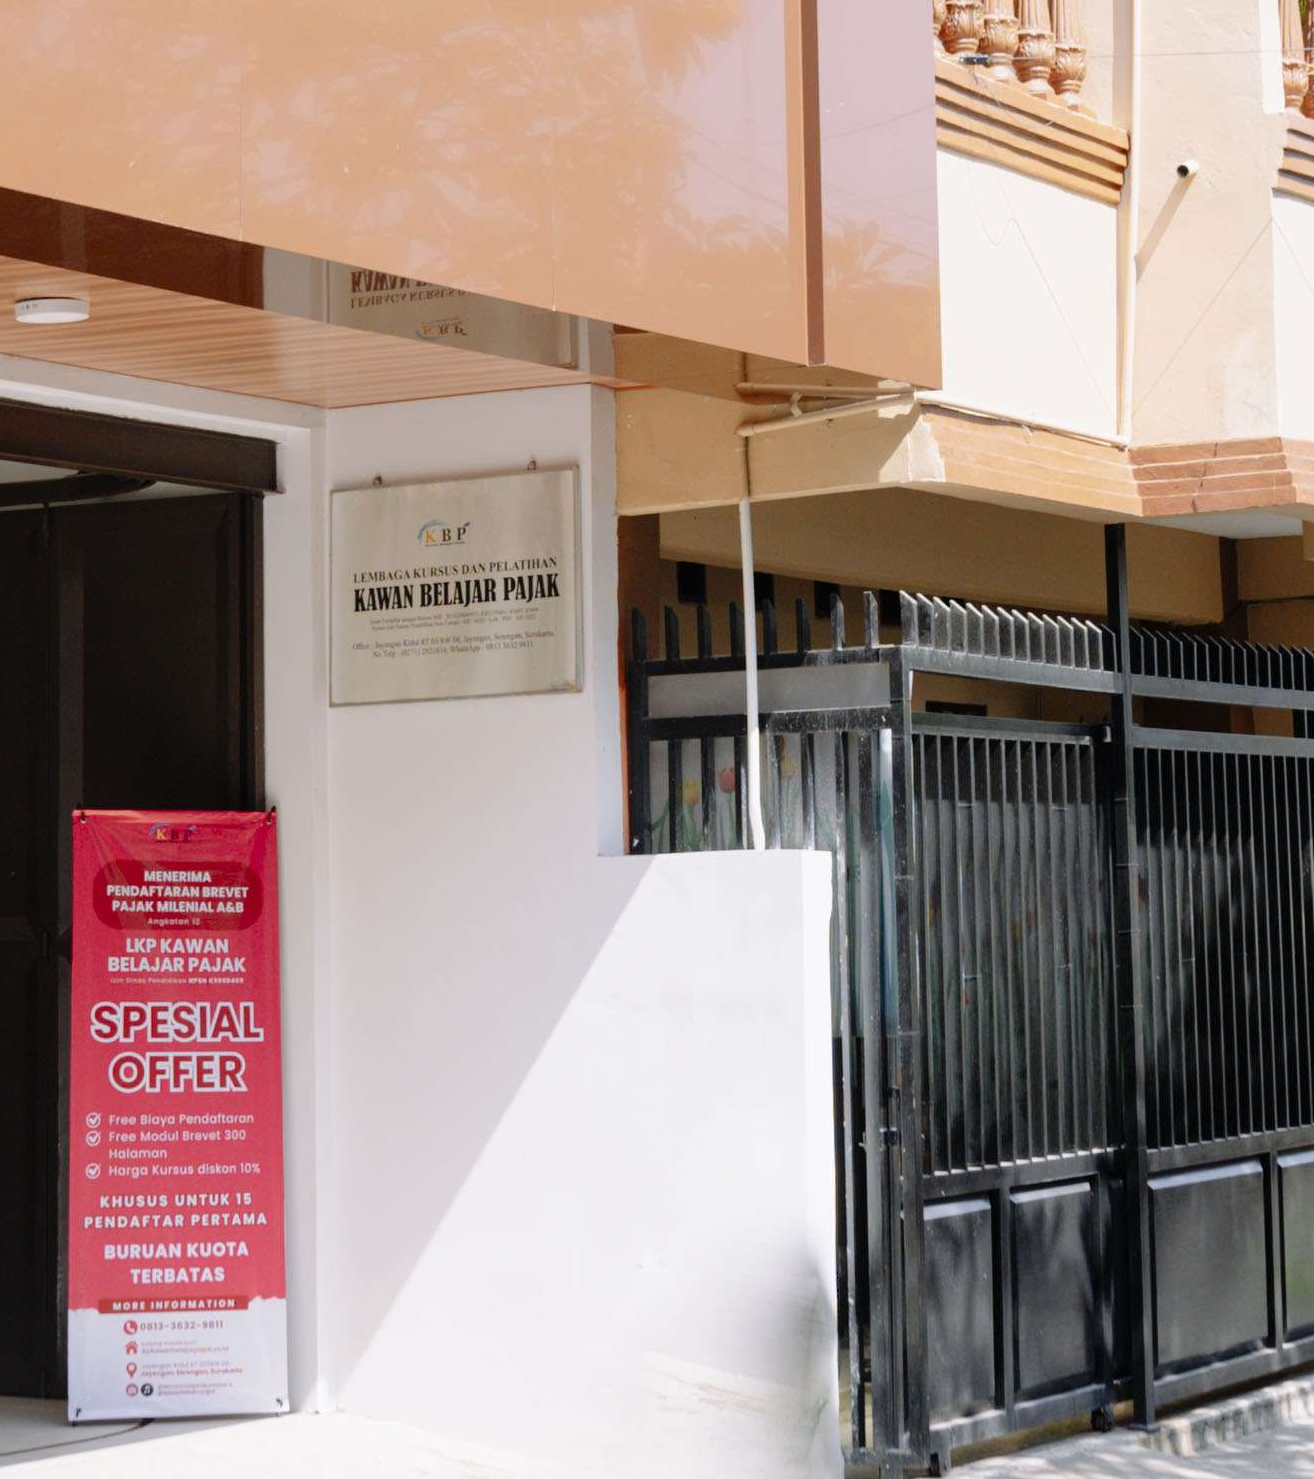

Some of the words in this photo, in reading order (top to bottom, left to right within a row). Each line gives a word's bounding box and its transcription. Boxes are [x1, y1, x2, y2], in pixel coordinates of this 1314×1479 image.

[354, 570, 411, 584] LEMBAGA
[414, 565, 458, 578] KURSUS
[462, 563, 486, 576] DAN
[489, 557, 557, 572] PELATIHAN
[354, 585, 413, 612] KAWAN
[421, 578, 496, 607] BELAJAR
[503, 574, 559, 602] PAJAK
[144, 871, 211, 883] MENERIMA
[107, 885, 200, 898] PENDAFTARAN
[202, 886, 249, 898] BREVET
[112, 901, 154, 912] PAJAK
[157, 901, 214, 913] MILENIAL
[217, 902, 244, 913] A&B
[126, 938, 157, 954] LKP
[160, 938, 229, 954] KAWAN
[108, 956, 184, 972] BELAJAR
[189, 957, 246, 972] PAJAK
[90, 1001, 264, 1043] SPESIAL
[109, 1052, 248, 1093] OFFER
[109, 1114, 137, 1126] Free
[141, 1114, 175, 1127] Biaya
[179, 1113, 254, 1124] Pendaftaran
[109, 1132, 137, 1142] Free
[141, 1131, 179, 1141] Modul
[183, 1130, 221, 1140] Brevet
[224, 1130, 246, 1140] 300
[109, 1148, 167, 1159] Halaman
[109, 1165, 148, 1178] Harga
[152, 1164, 193, 1176] Kursus
[198, 1163, 236, 1174] diskon
[240, 1163, 261, 1174] 10%
[100, 1195, 168, 1208] KHUSUS
[175, 1193, 230, 1206] UNTUK
[236, 1193, 252, 1205] 15
[84, 1215, 184, 1228] PENDAFTAR
[191, 1213, 267, 1226] PERTAMA
[104, 1244, 181, 1260] BURUAN
[187, 1241, 249, 1258] KUOTA
[131, 1267, 225, 1284] TERBATAS
[113, 1301, 145, 1311] MORE
[151, 1299, 236, 1310] INFORMATION
